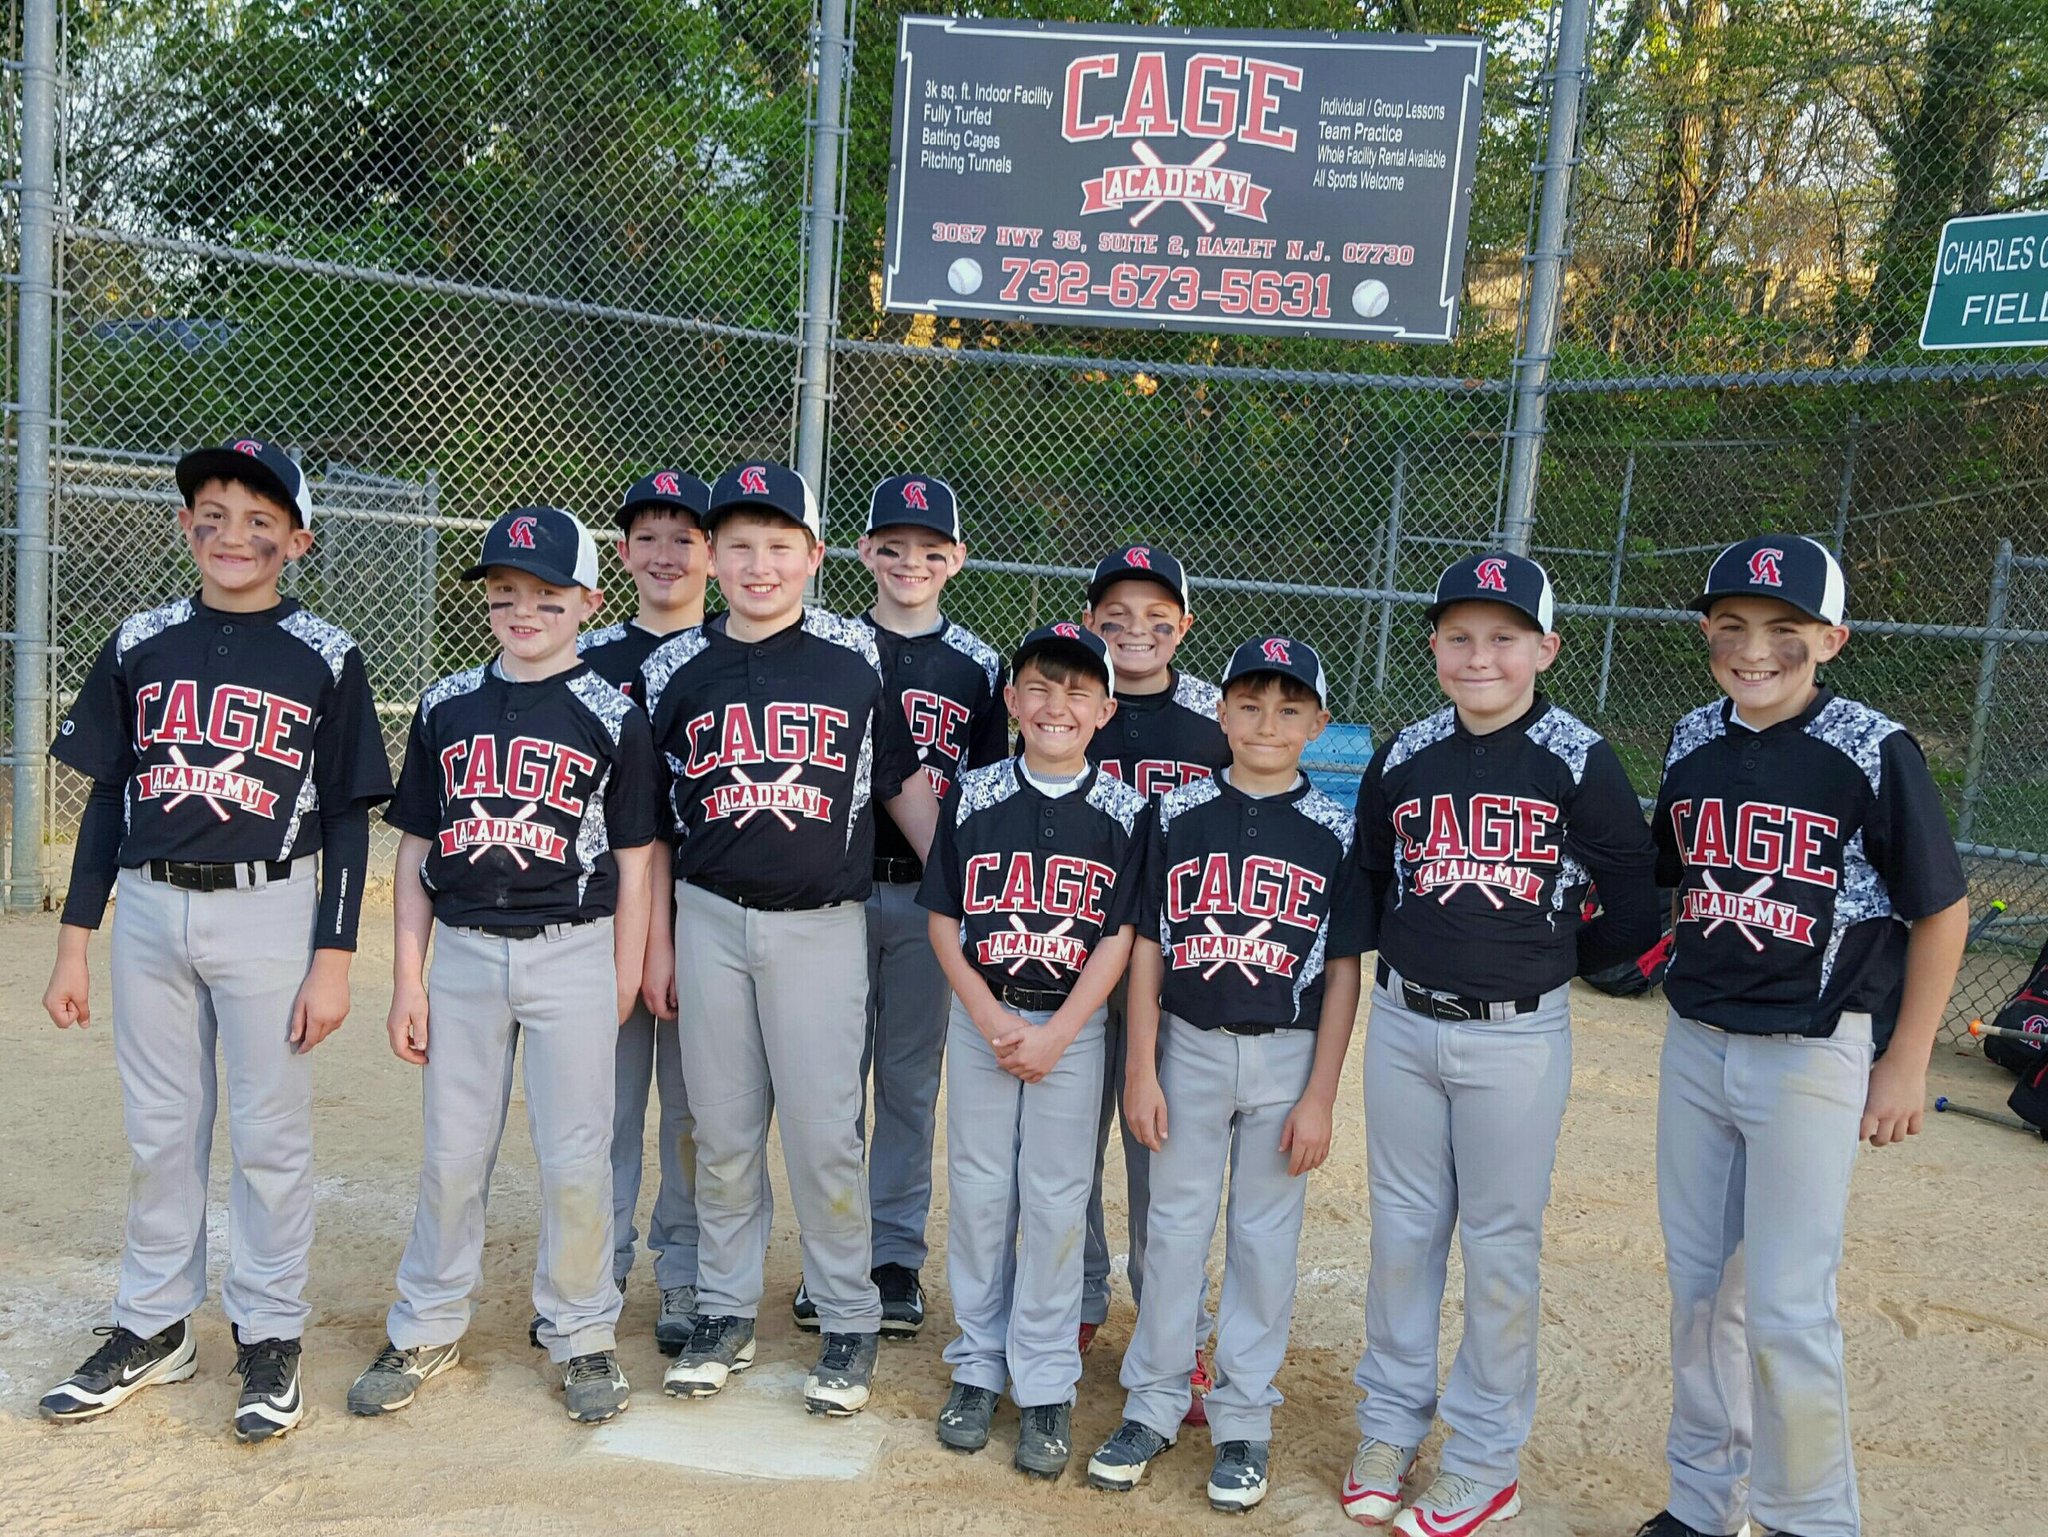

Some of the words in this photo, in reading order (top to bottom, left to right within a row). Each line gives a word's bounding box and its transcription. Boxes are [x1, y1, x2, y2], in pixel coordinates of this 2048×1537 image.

[924, 80, 938, 98] 3k
[941, 84, 957, 104] sq.
[961, 82, 971, 101] ft.
[975, 82, 1011, 103] Indoor
[1014, 85, 1053, 110] Facility
[1061, 51, 1304, 153] CAGE
[1320, 96, 1366, 117] Individual
[1373, 98, 1403, 122] Group
[1405, 100, 1446, 120] Lessons
[923, 103, 951, 127] Fully
[954, 105, 992, 126] Turfed
[1318, 121, 1351, 140] Team
[1354, 122, 1403, 143] Practice
[922, 127, 960, 150] Batting
[963, 130, 1000, 152] Cages
[1317, 144, 1345, 164] Whole
[1346, 145, 1377, 169] Facility
[1378, 147, 1407, 167] Rental
[1407, 148, 1446, 169] Available
[920, 150, 965, 175] Pitching
[968, 153, 1012, 174] Tunnels
[1312, 169, 1325, 187] All
[1327, 169, 1357, 192] Sports
[1360, 171, 1405, 191] Welcome
[1106, 168, 1247, 205] ACADEMY
[931, 222, 987, 244] 3057
[995, 226, 1043, 248] HWY
[1052, 229, 1087, 254] 35,
[1098, 232, 1158, 255] SUITE
[1167, 235, 1190, 259] 2,
[1196, 236, 1277, 260] HAZLET
[1285, 239, 1332, 262] N.J.
[1342, 242, 1415, 267] 07730
[1943, 235, 2036, 275] CHARLES
[999, 256, 1331, 318] 732-673-5631
[136, 679, 312, 771] CAGE
[685, 702, 849, 779] CAGE
[901, 688, 970, 761] GE
[153, 767, 260, 804] ACADEMY
[440, 734, 597, 818] CAGE
[719, 784, 818, 811] ACADEMY
[458, 820, 552, 851] ACADEMY
[1393, 793, 1559, 864] CAGE
[1669, 798, 1839, 890] CAGE
[963, 852, 1117, 929] CAGE
[1167, 853, 1326, 932] CAGE
[1422, 859, 1528, 889] ACADEMY
[1691, 891, 1792, 930] ACADEMY
[991, 933, 1082, 962] ACADEMY
[1189, 937, 1284, 966] ACADEMY
